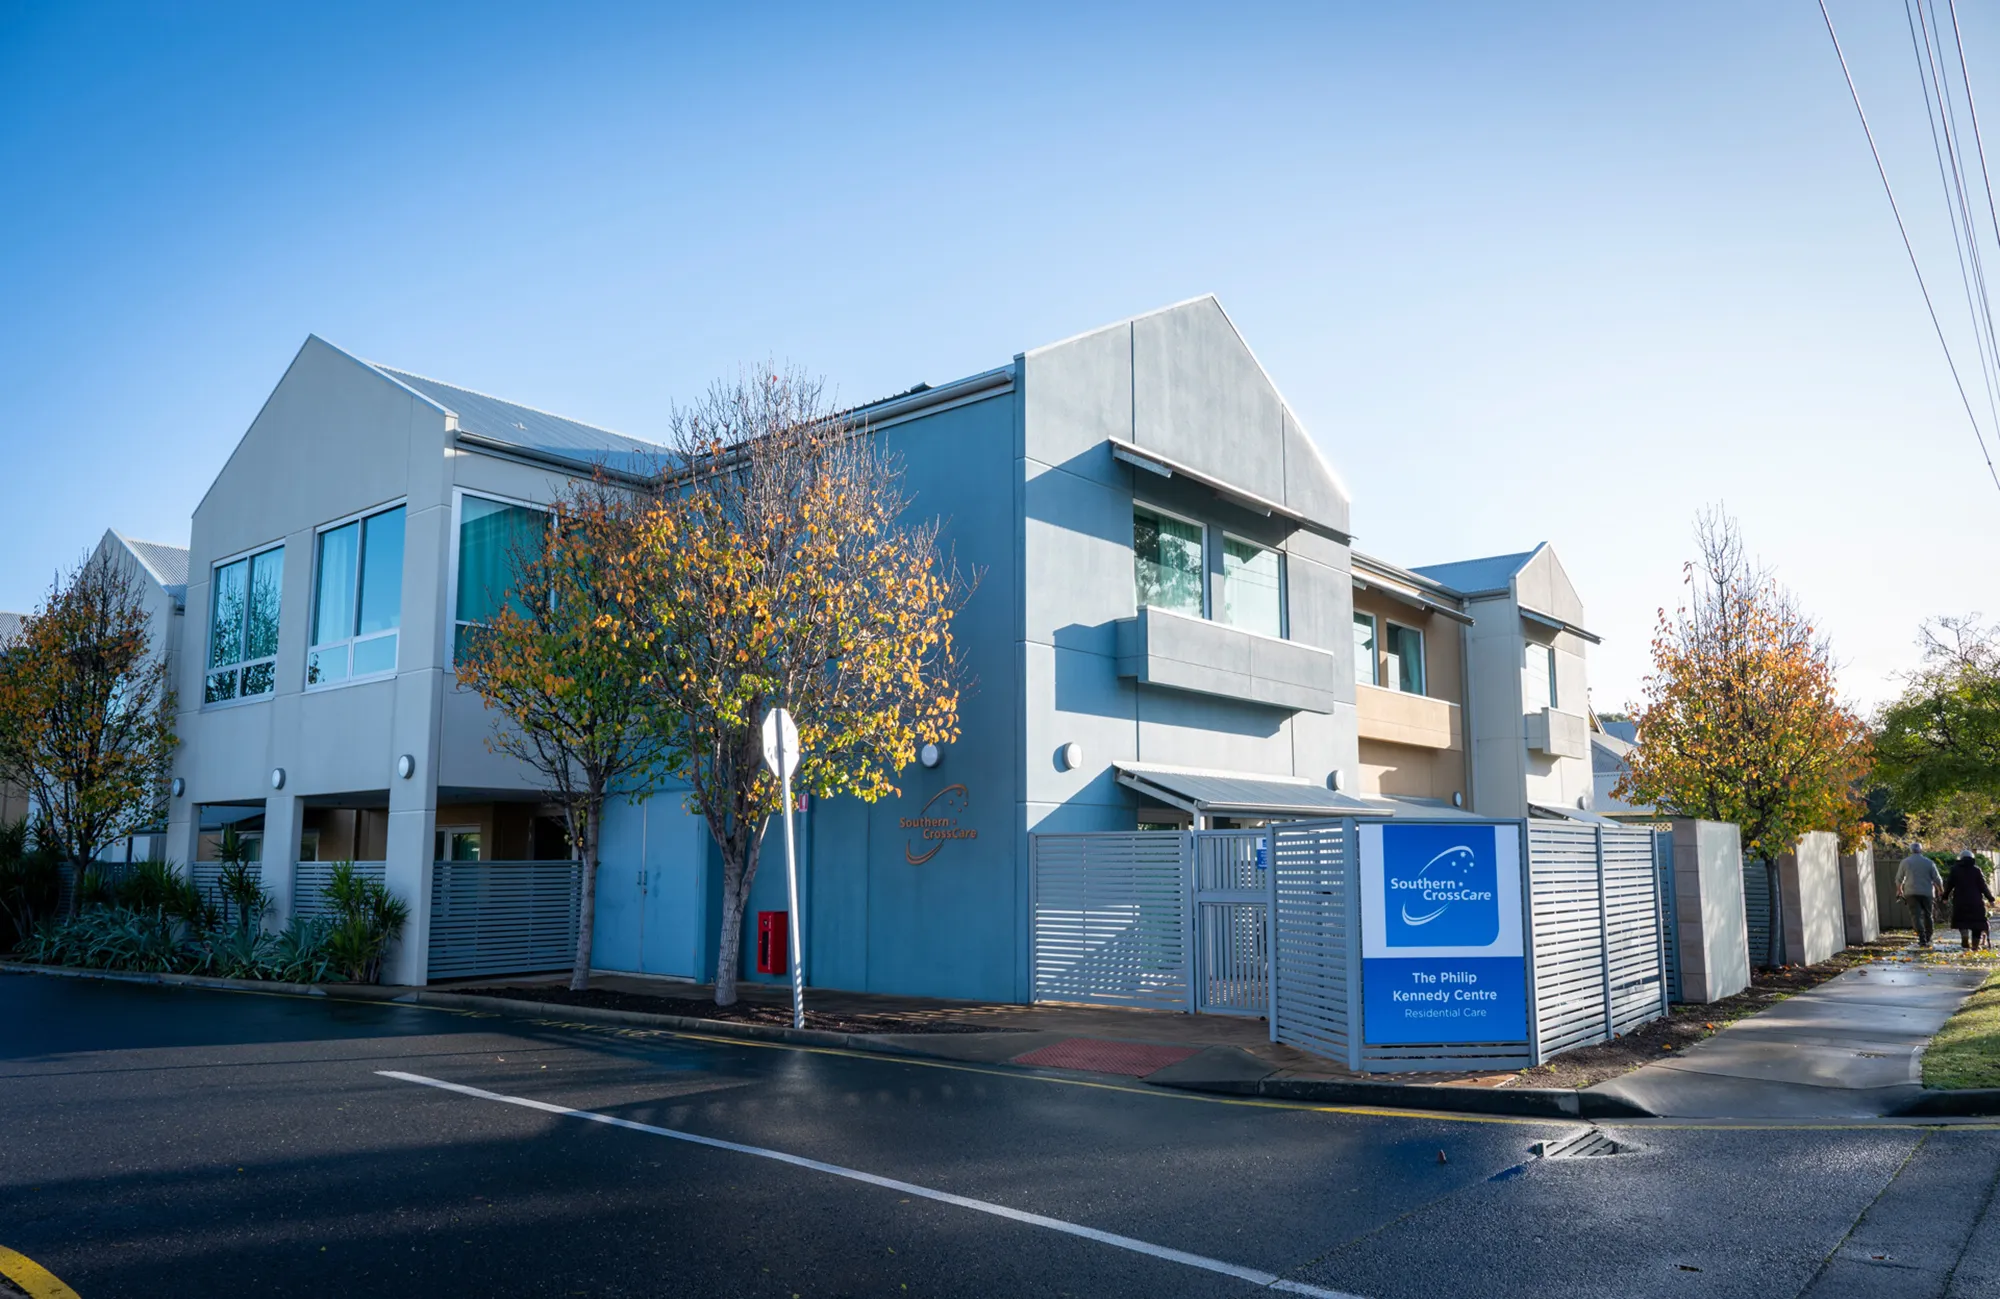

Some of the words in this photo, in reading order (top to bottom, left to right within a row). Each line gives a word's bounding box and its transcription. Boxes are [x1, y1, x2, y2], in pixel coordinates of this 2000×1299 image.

[899, 817, 949, 828] Southern
[923, 828, 977, 840] CrossCare
[1390, 877, 1456, 890] Southern
[1422, 889, 1492, 901] CrossCare
[1412, 972, 1437, 984] The
[1440, 971, 1478, 985] Philip
[1393, 989, 1450, 1003] Kennedy
[1453, 989, 1498, 1001] Centre
[1404, 1007, 1461, 1018] Residential
[1463, 1007, 1487, 1018] Care
